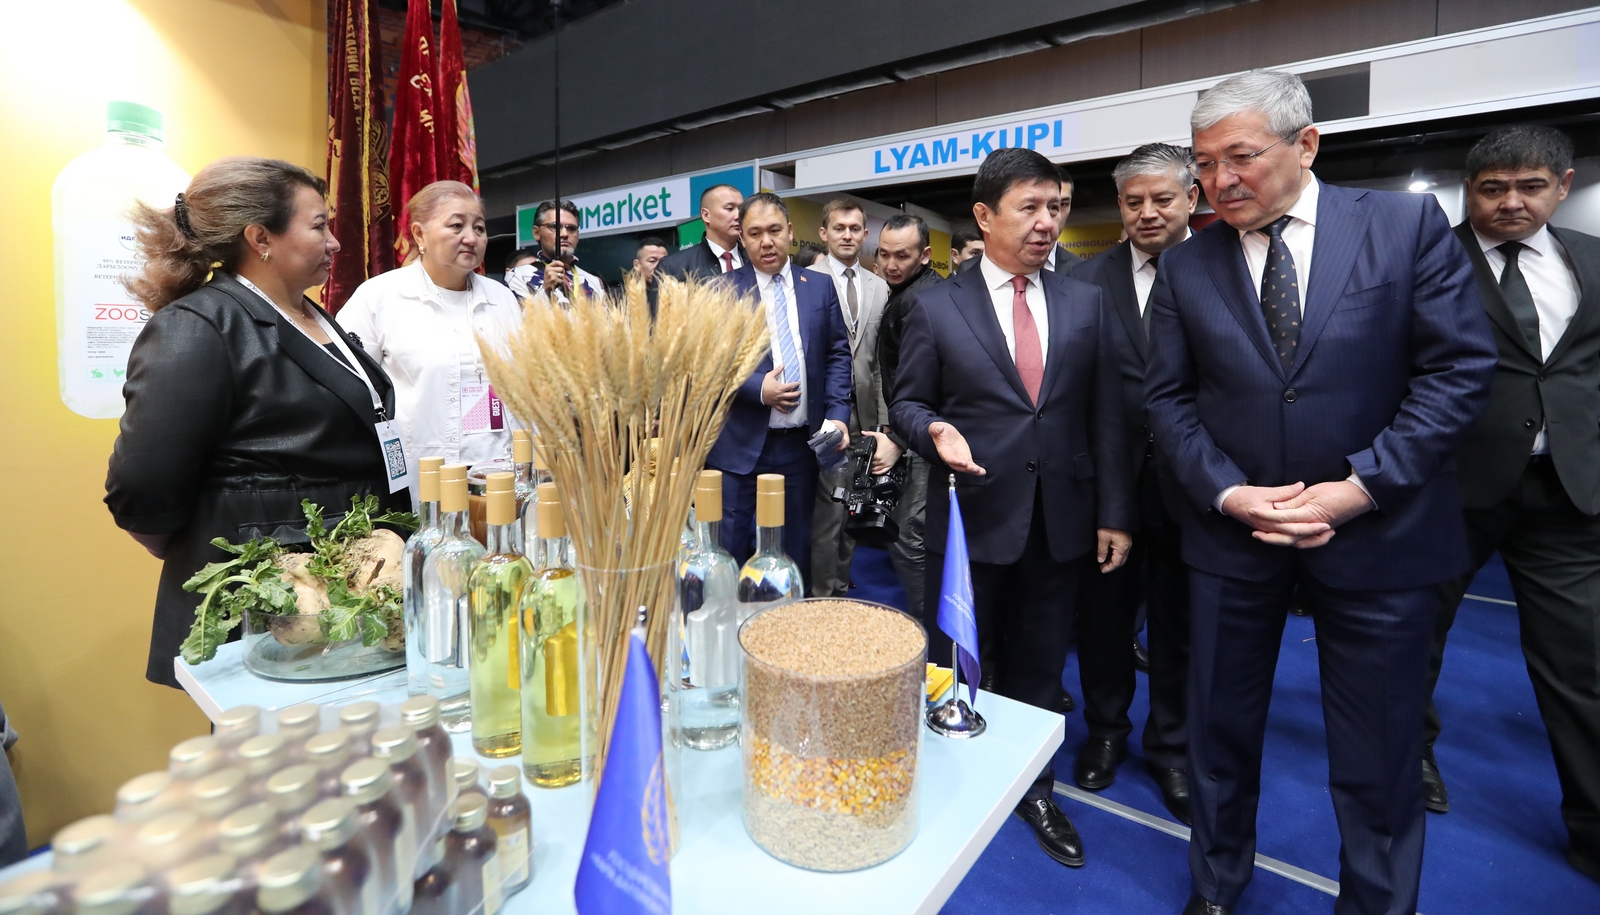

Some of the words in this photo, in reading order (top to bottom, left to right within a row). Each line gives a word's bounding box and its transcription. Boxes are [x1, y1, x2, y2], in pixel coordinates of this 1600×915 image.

[874, 119, 1063, 174] LYAM-KUPI
[95, 307, 149, 321] ZOOS
[491, 397, 500, 417] GUEST
